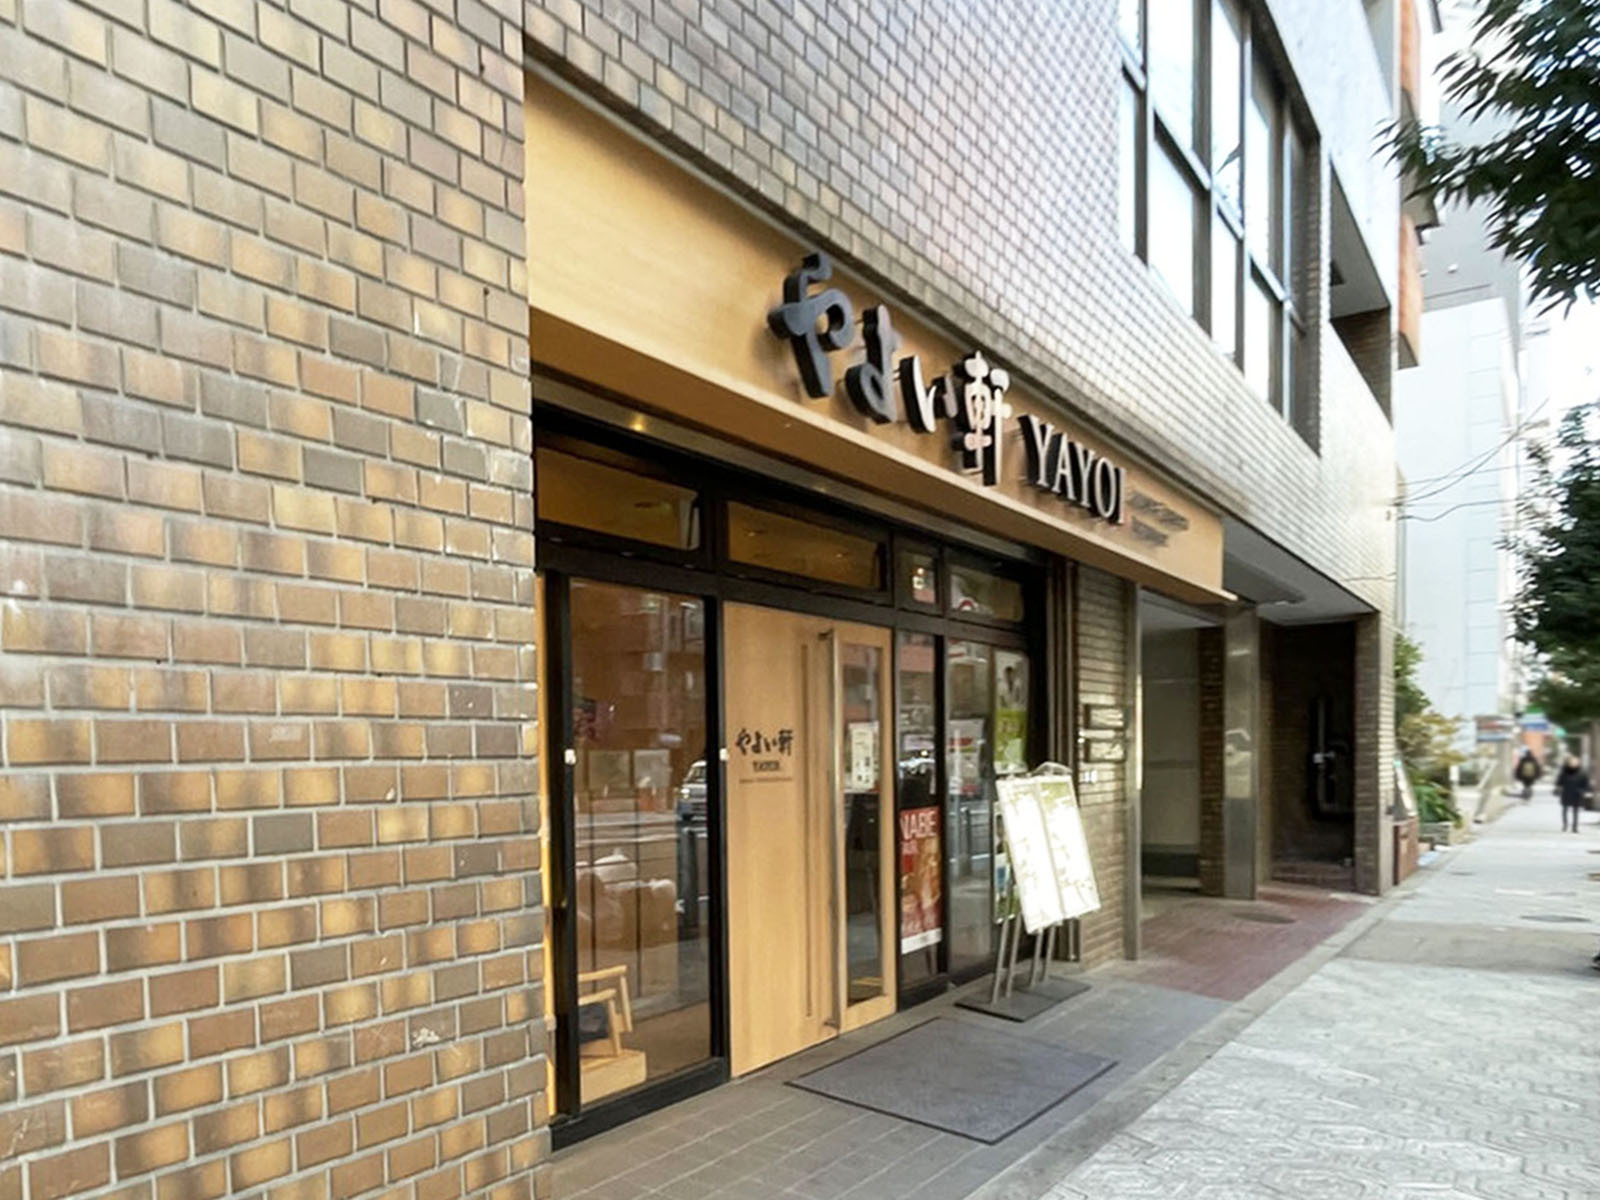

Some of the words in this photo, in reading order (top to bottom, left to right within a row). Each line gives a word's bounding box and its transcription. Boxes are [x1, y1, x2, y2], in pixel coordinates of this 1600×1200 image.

[768, 253, 1011, 485] やよい軒
[1020, 416, 1124, 525] YAYOI
